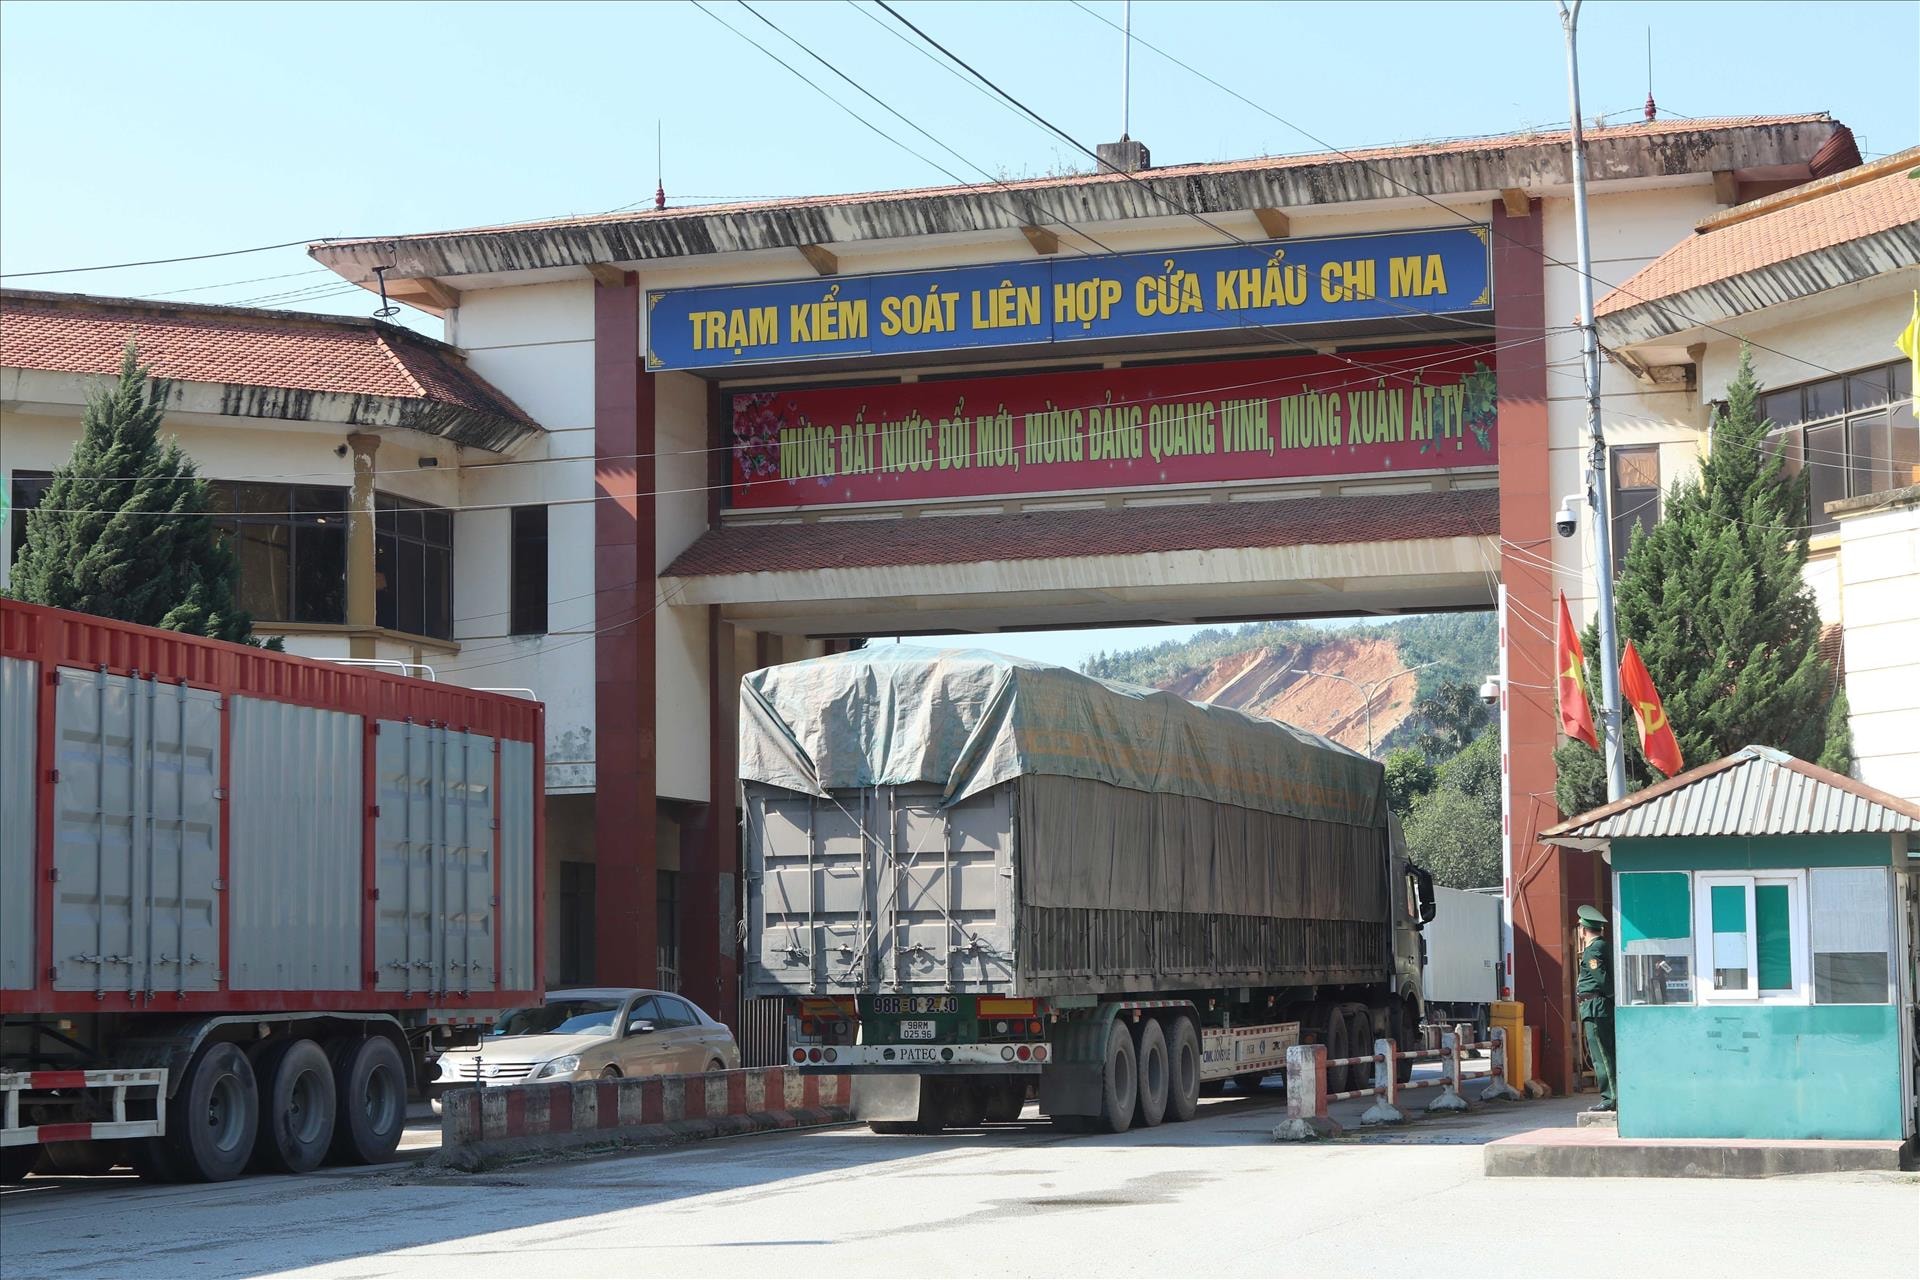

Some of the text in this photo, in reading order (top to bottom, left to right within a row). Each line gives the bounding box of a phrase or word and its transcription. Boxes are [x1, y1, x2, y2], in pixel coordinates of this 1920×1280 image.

[689, 249, 1448, 354] TRẠM KIỂM SOÁT LIÊN HỢP CỬA KHẨU CHI MA
[780, 416, 835, 479] MỪNG
[841, 405, 876, 476] ĐẤT
[881, 410, 933, 473] NƯỚC
[938, 396, 970, 470] ĐỔI
[976, 403, 1019, 472] MỚI,
[1025, 400, 1083, 465] MỪNG
[1089, 389, 1143, 460] ĐẢNG
[1148, 400, 1215, 463] QUANG
[1221, 398, 1274, 457] VINH,
[1280, 383, 1341, 449] MỪNG
[1347, 377, 1404, 445] XUÂN
[1410, 367, 1434, 441] ẤT
[907, 1021, 929, 1030] 98RM
[903, 1030, 932, 1039] 025.96
[900, 1048, 937, 1061] PATEC
